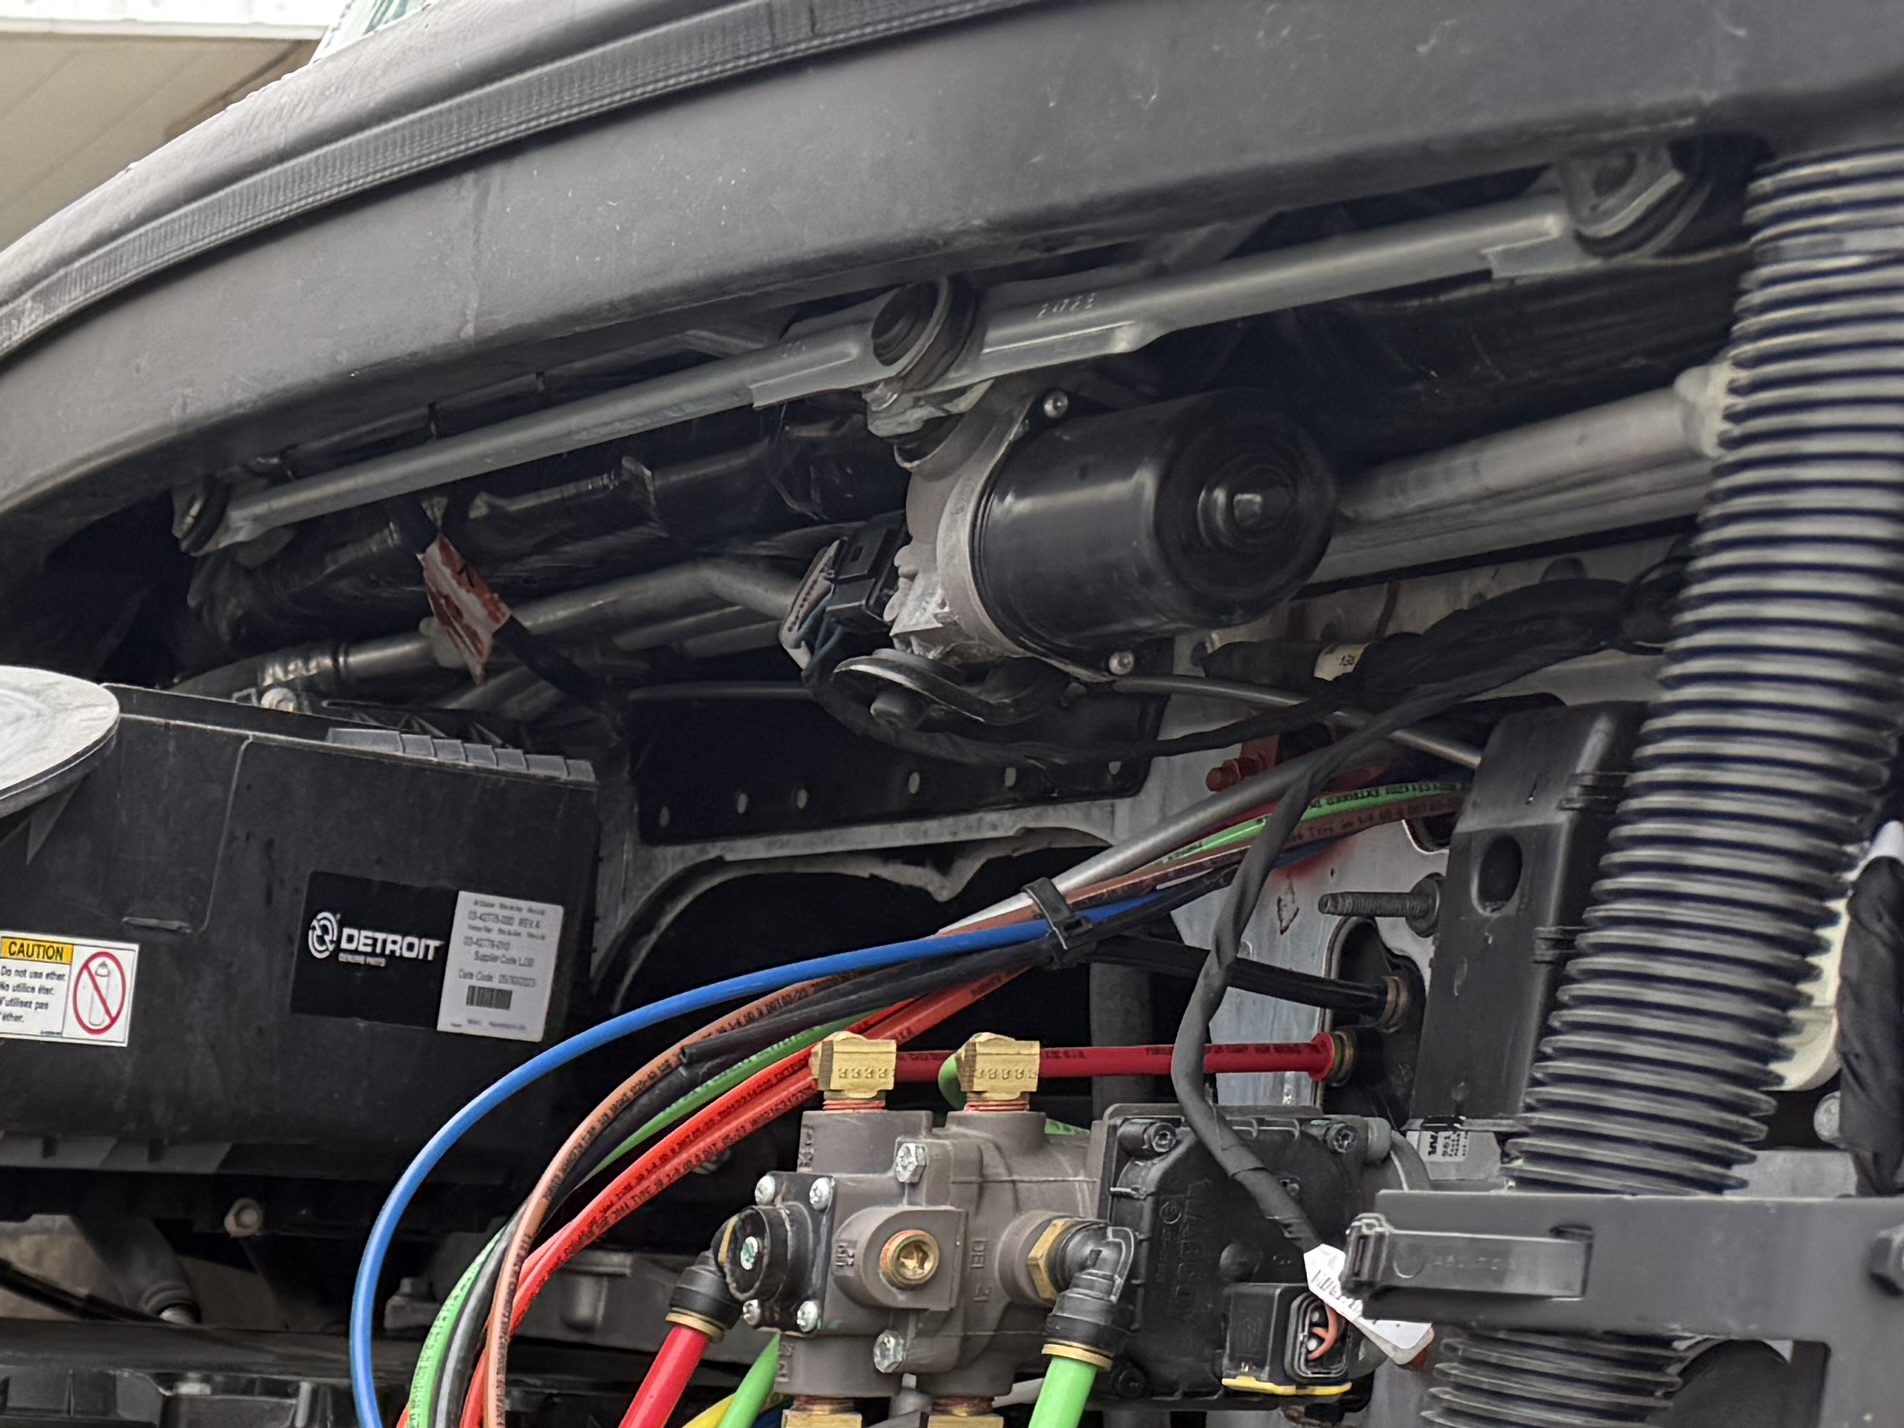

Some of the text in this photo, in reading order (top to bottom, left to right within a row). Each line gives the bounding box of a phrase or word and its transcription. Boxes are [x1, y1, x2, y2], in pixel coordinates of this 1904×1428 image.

[8, 941, 64, 961] CAUTION
[340, 928, 441, 960] DETROIT
[1, 966, 11, 976] Do
[14, 968, 27, 978] not
[29, 970, 42, 979] use
